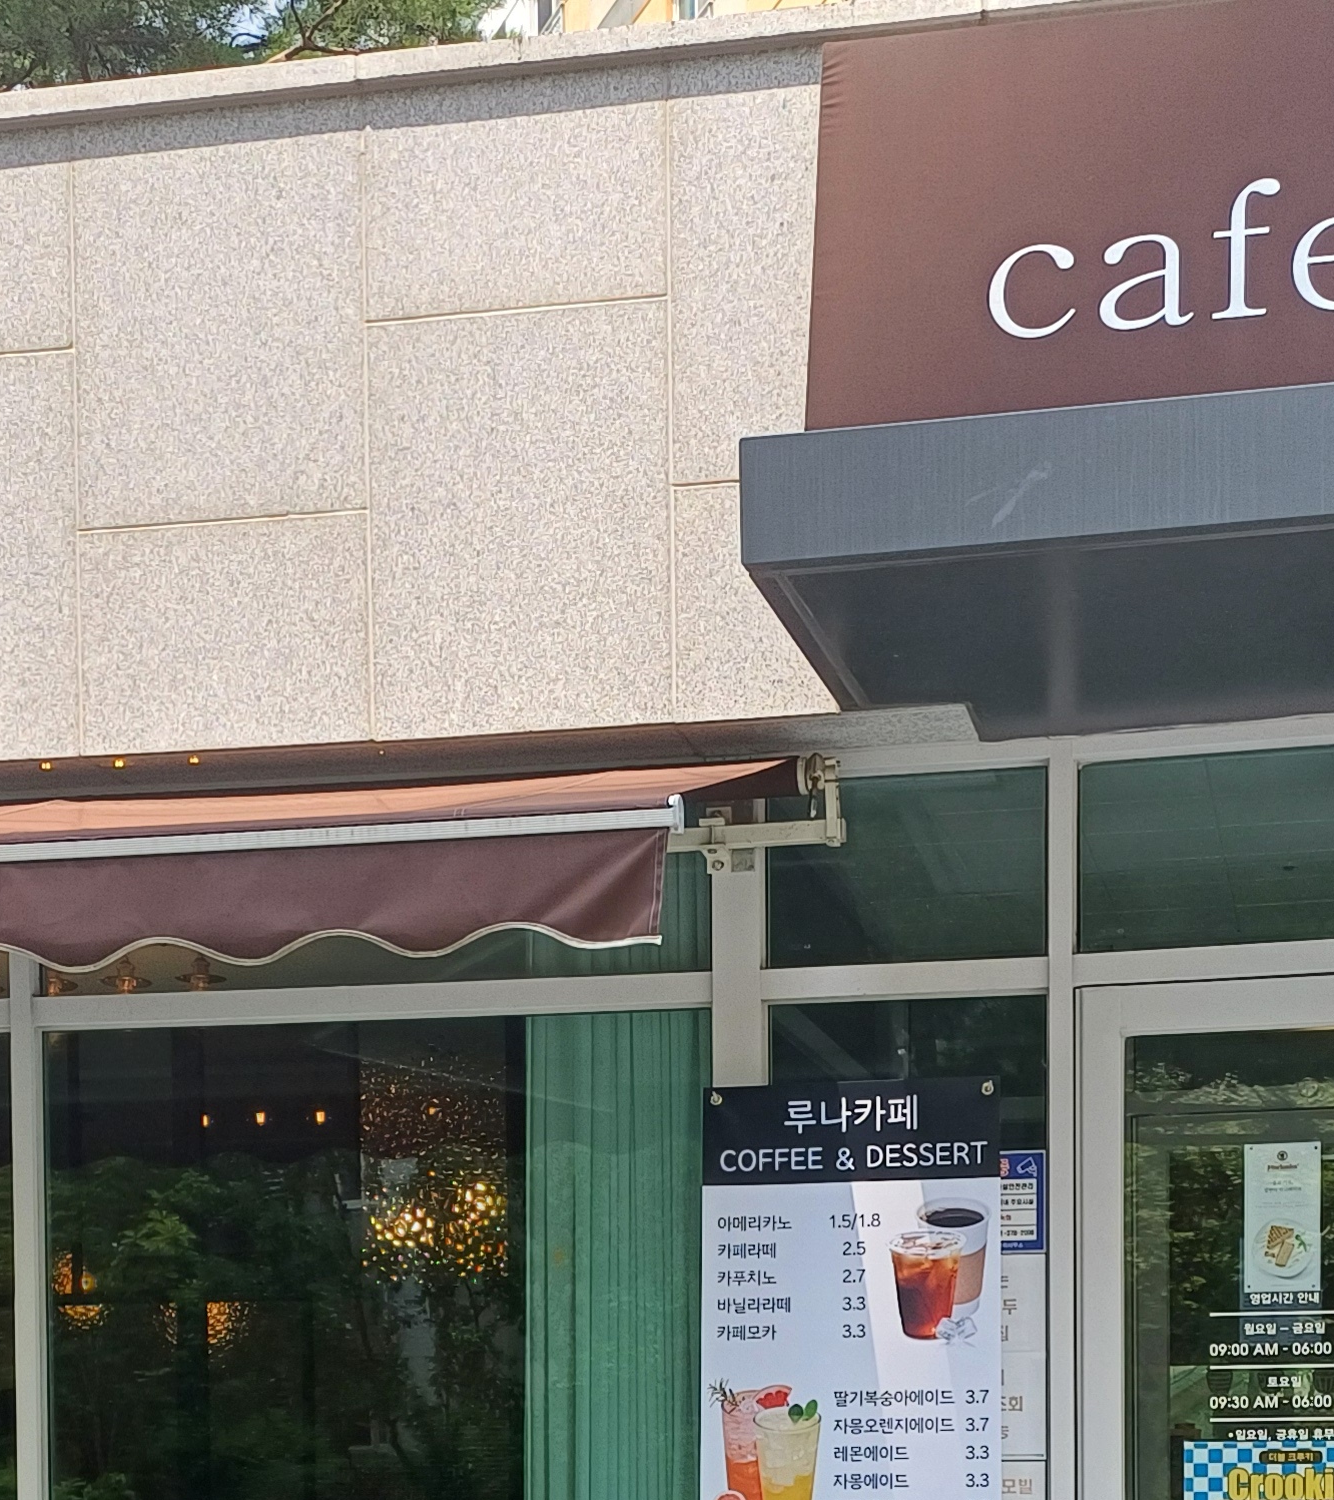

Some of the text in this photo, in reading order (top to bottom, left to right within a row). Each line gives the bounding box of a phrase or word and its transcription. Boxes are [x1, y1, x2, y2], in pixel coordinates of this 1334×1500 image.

[784, 1094, 919, 1135] 루나카페
[719, 1147, 824, 1173] COFFEE
[835, 1147, 856, 1171] &
[866, 1141, 989, 1169] DESSERT
[717, 1213, 881, 1232] 아메리카노 1.5/1.8
[717, 1242, 866, 1259] 카페라떼 2.5
[717, 1269, 866, 1286] 카푸치노 2.7
[717, 1297, 866, 1314] 바닐라라떼 3.3
[1250, 1292, 1320, 1306] 영업시간 안내
[717, 1324, 866, 1341] 카페모카 3.3
[1244, 1322, 1277, 1336] 월요일
[1292, 1322, 1326, 1335] 금요일
[1209, 1343, 1248, 1357] 09:00
[1253, 1343, 1279, 1356] AM
[1292, 1342, 1331, 1356] 06:00
[1267, 1375, 1302, 1388] 토요일
[834, 1389, 989, 1408] 딸기복숭아에이드 3.7
[1209, 1396, 1249, 1410] 09:30
[1253, 1396, 1279, 1409] AM
[1292, 1395, 1331, 1409] 06:00
[833, 1418, 955, 1435] 자몽오렌지에이드
[965, 1418, 989, 1432] 3.7
[833, 1446, 989, 1462] 레몬에이드 3.3
[833, 1473, 990, 1490] 자몽에이드 3.3
